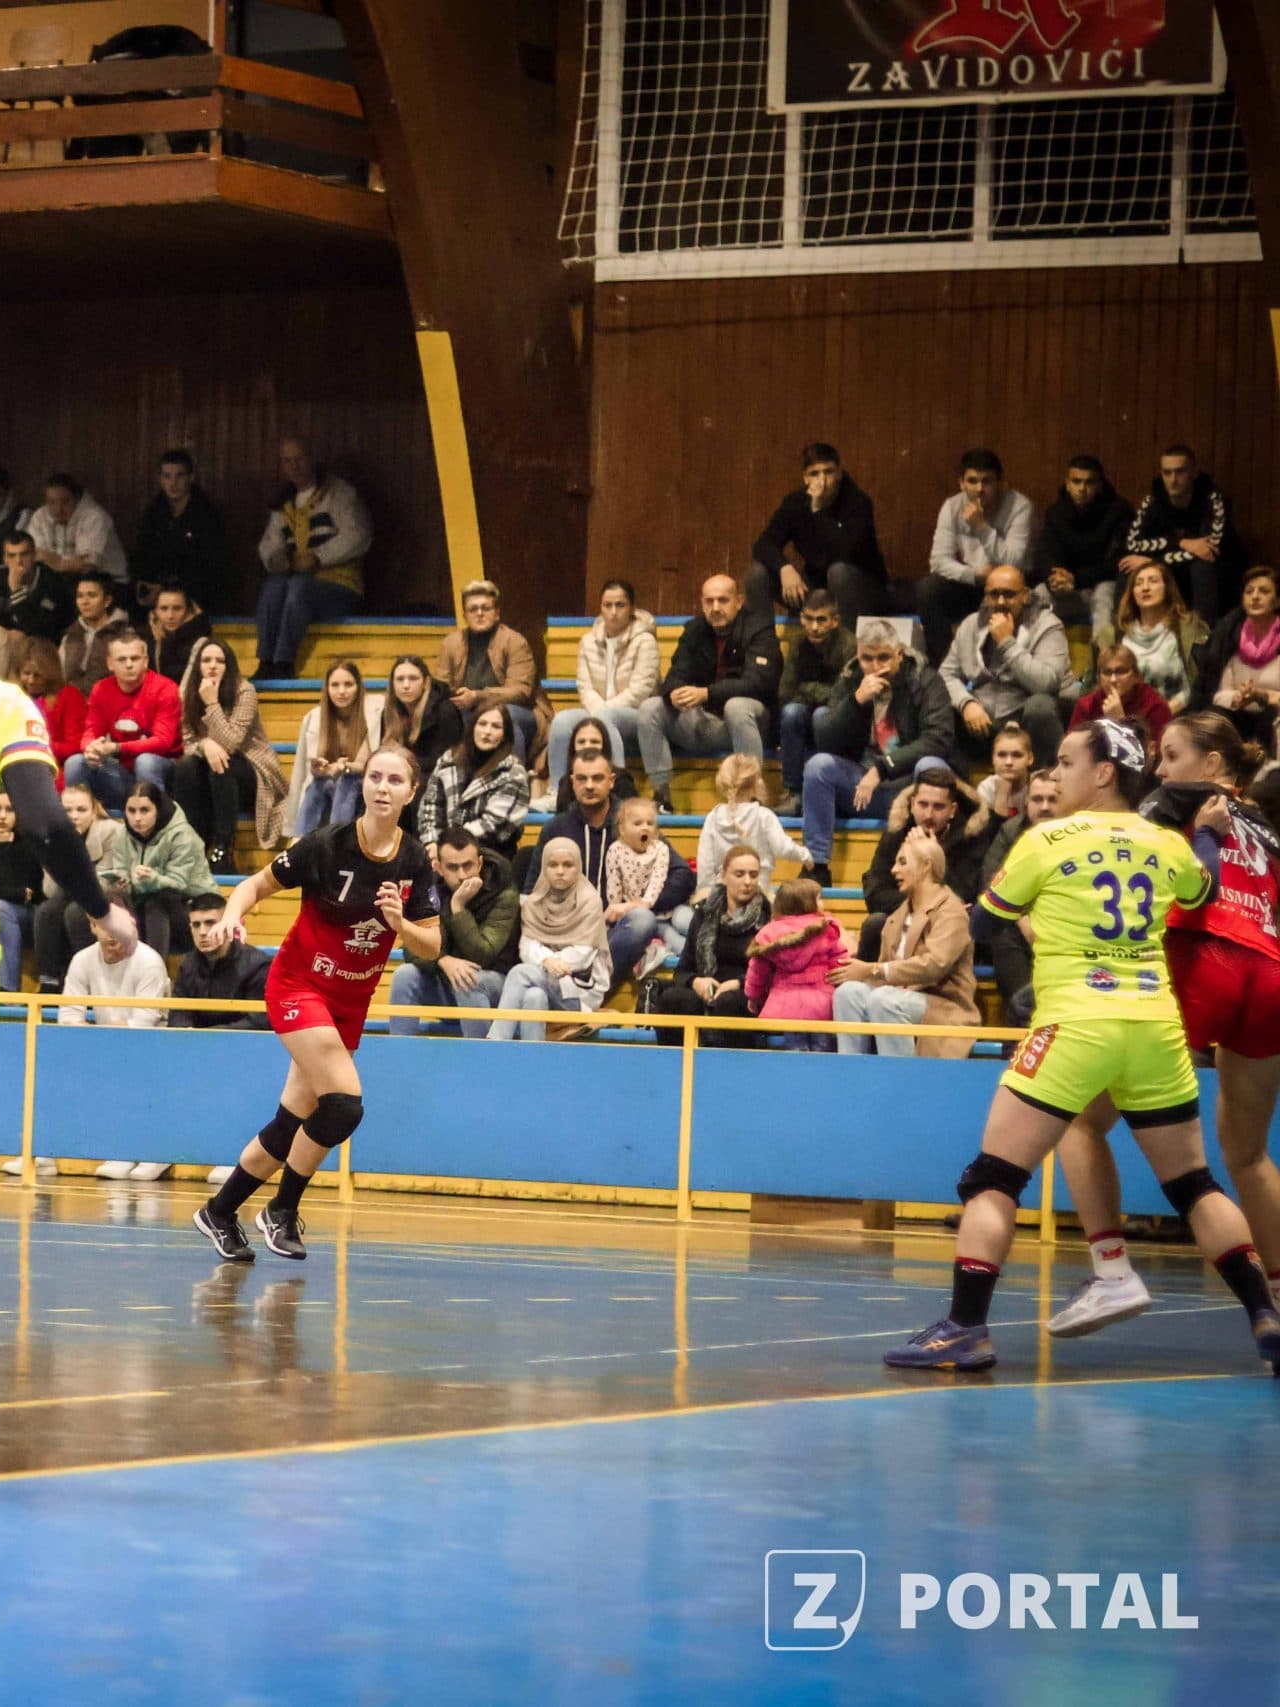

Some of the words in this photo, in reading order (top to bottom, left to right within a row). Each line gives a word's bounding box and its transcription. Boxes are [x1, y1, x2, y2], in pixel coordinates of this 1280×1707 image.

[846, 39, 1146, 92] ZAVIDOVIĆI
[338, 870, 355, 903] 7
[1060, 848, 1176, 882] BORAC
[1091, 870, 1154, 941] 33
